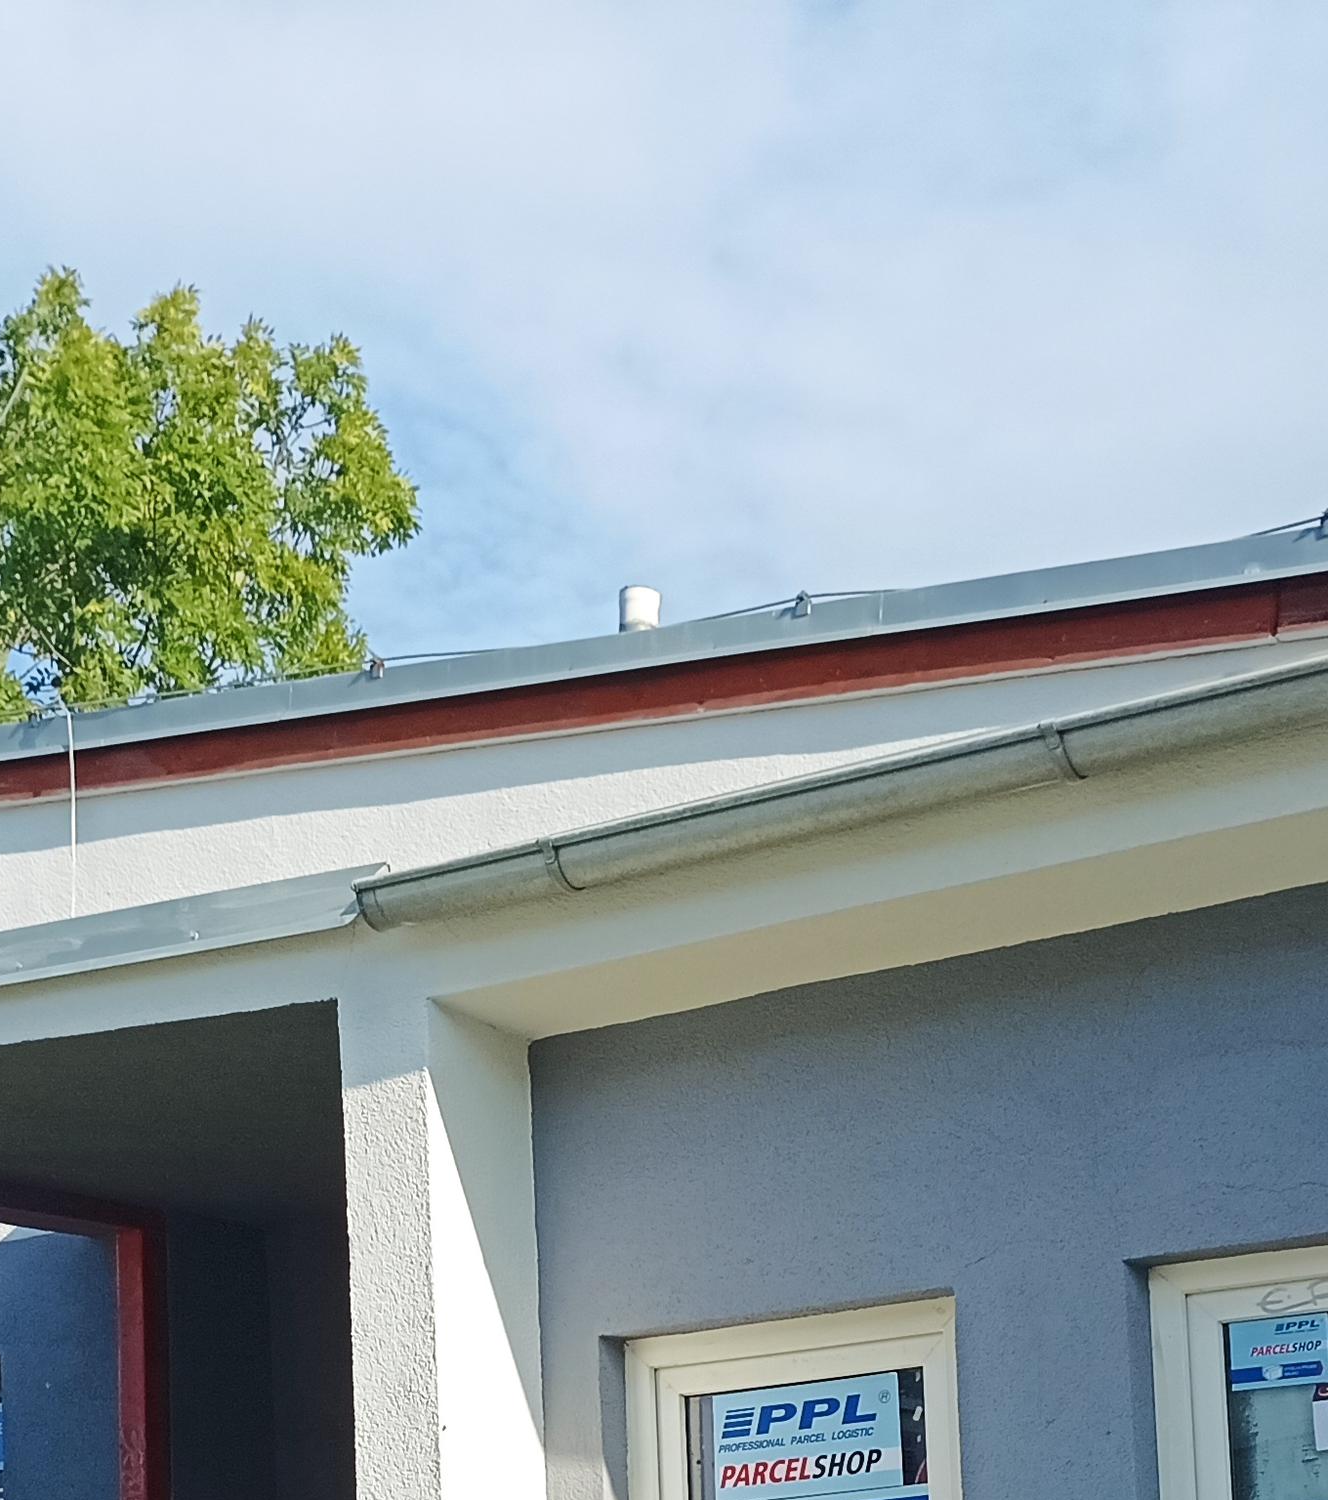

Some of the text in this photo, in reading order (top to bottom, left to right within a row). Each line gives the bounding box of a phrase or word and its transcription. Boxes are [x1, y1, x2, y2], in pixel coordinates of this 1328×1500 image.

[1250, 1339, 1322, 1357] PARCELSHOP
[755, 1394, 877, 1435] PPL
[718, 1427, 875, 1453] PROFESSIONAL PARCEL LOGISTIC
[720, 1449, 882, 1489] PARCELSHOP
